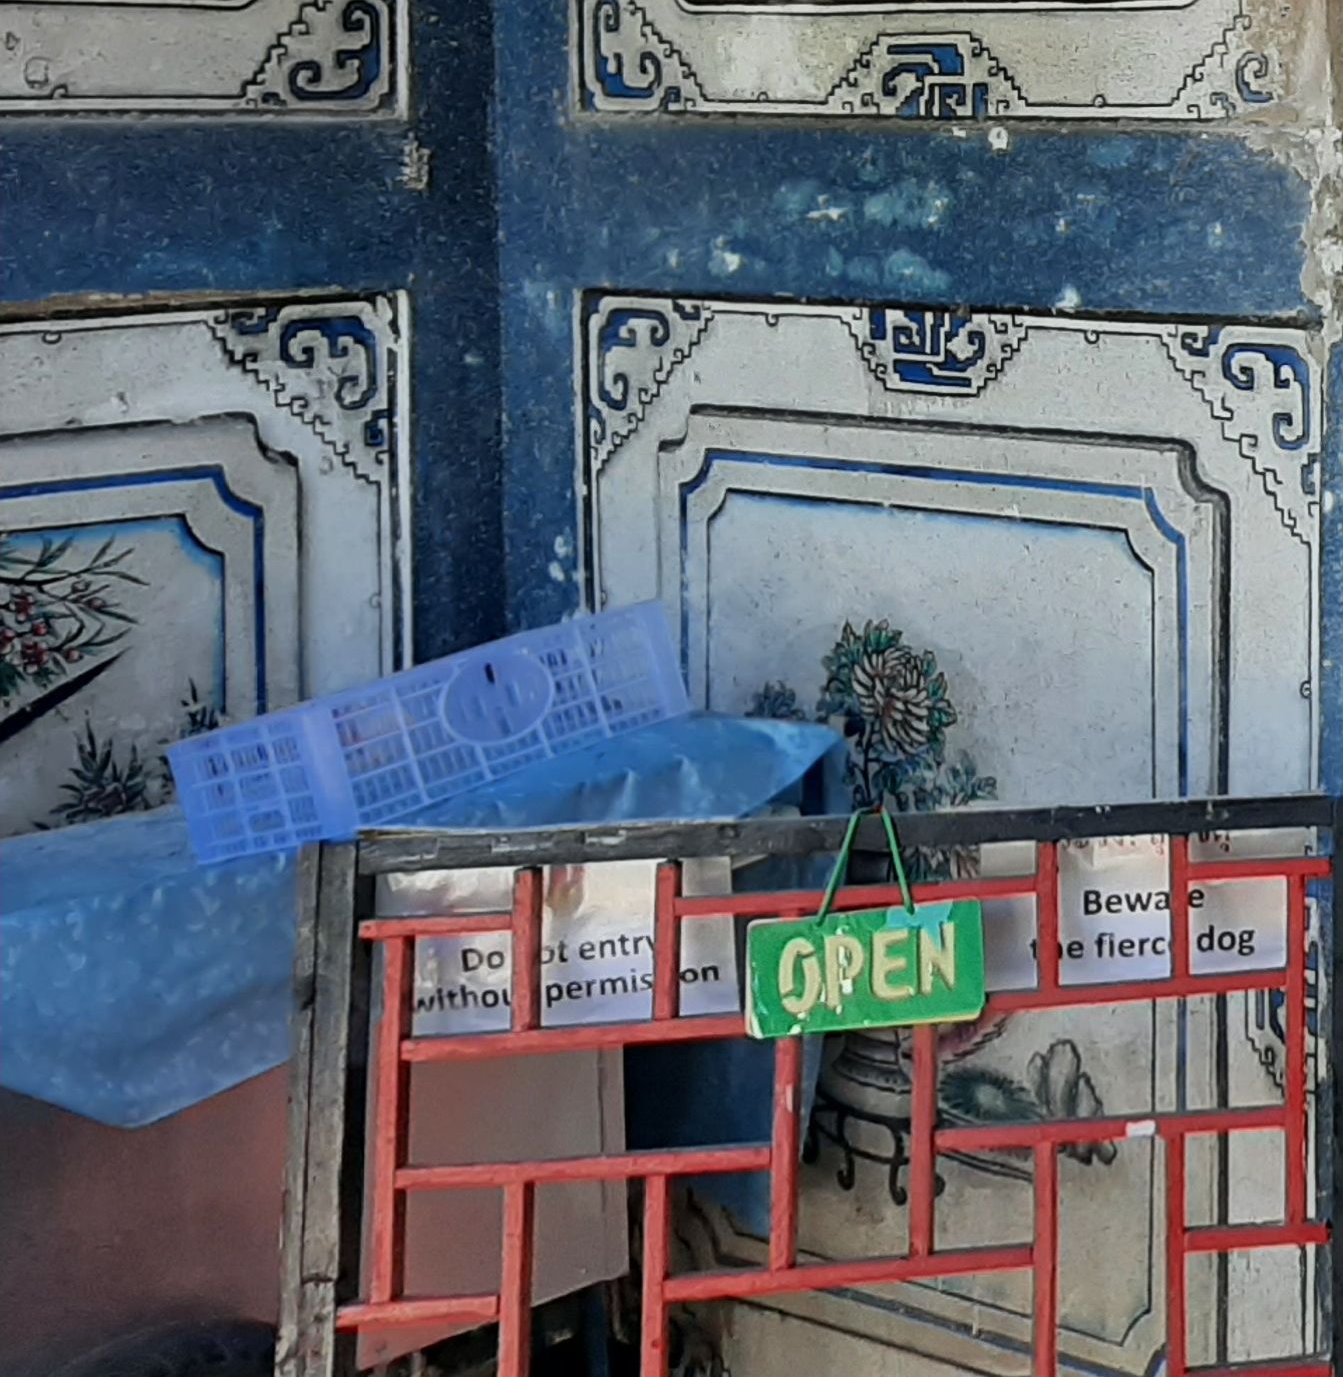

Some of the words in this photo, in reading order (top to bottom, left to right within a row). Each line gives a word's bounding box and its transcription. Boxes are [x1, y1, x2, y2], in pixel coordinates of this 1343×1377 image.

[1084, 889, 1205, 915] Bewae
[461, 947, 505, 972] Do
[1030, 938, 1083, 961] te
[1096, 932, 1170, 957] fierc
[1197, 925, 1256, 956] dog
[546, 964, 719, 1007] permison
[778, 923, 957, 1015] OPEN
